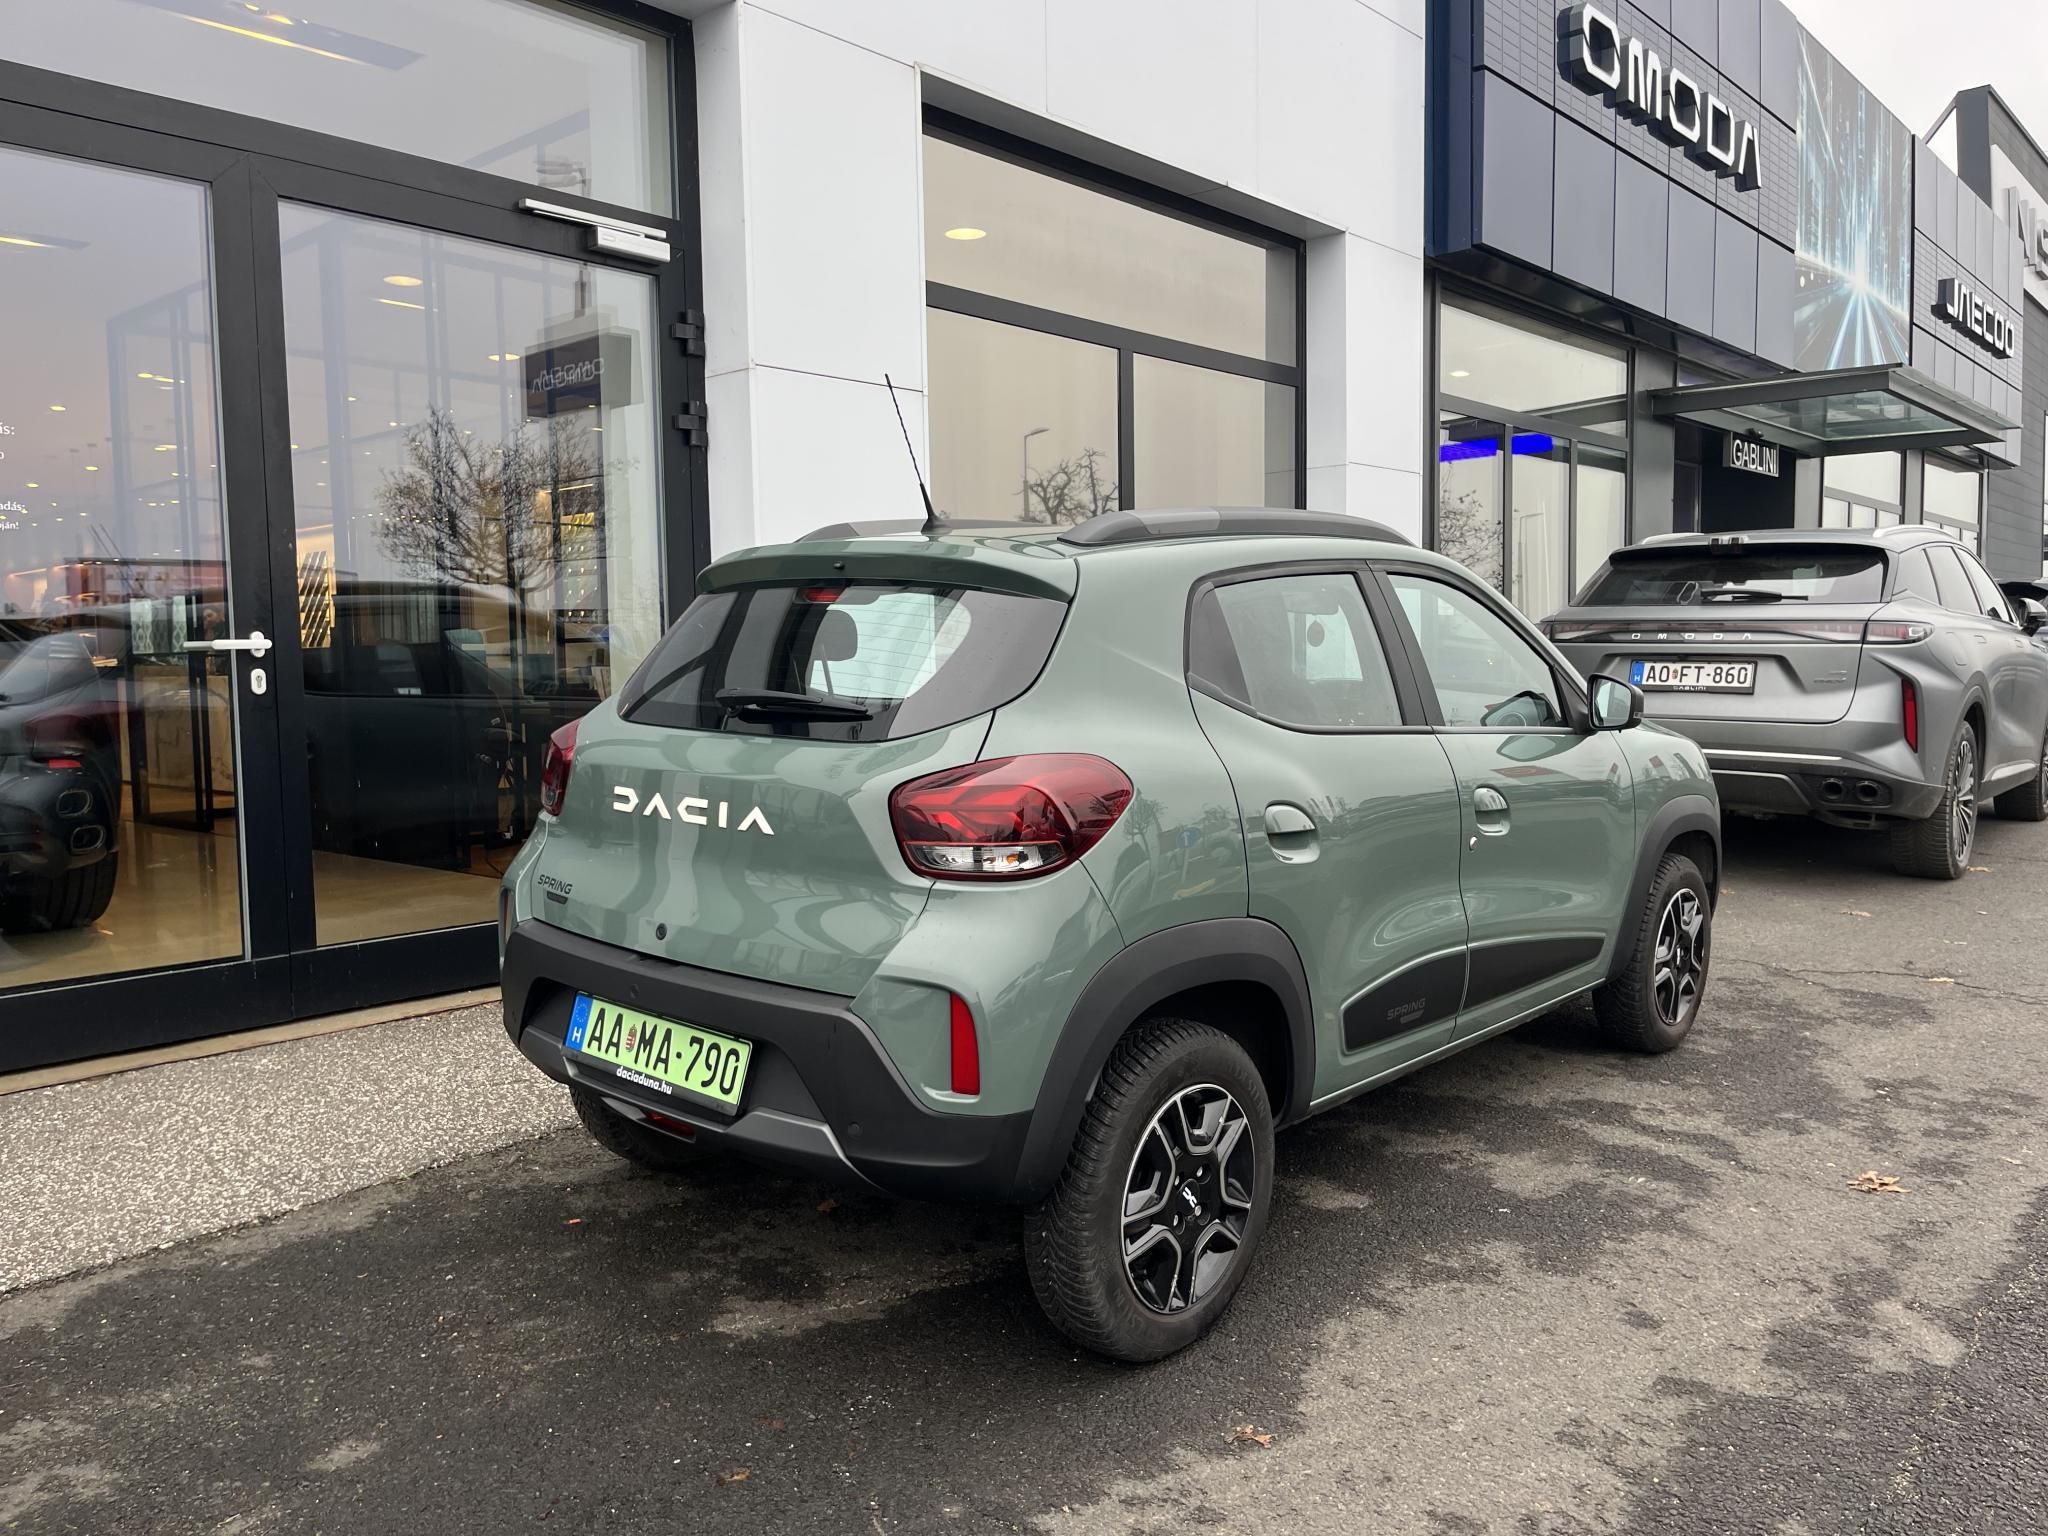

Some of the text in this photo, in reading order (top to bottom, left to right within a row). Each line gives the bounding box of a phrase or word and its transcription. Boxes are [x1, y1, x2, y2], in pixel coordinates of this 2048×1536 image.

[1582, 2, 1762, 188] OMODA
[1946, 277, 2015, 358] JAECOO
[1733, 439, 1777, 475] GABLINI
[0, 521, 19, 531] ján!
[613, 785, 775, 835] DACIA
[537, 873, 573, 895] SPRING
[1386, 997, 1427, 1021] SPRING
[571, 1027, 582, 1043] H
[616, 1065, 673, 1096] daciaduna.hu
